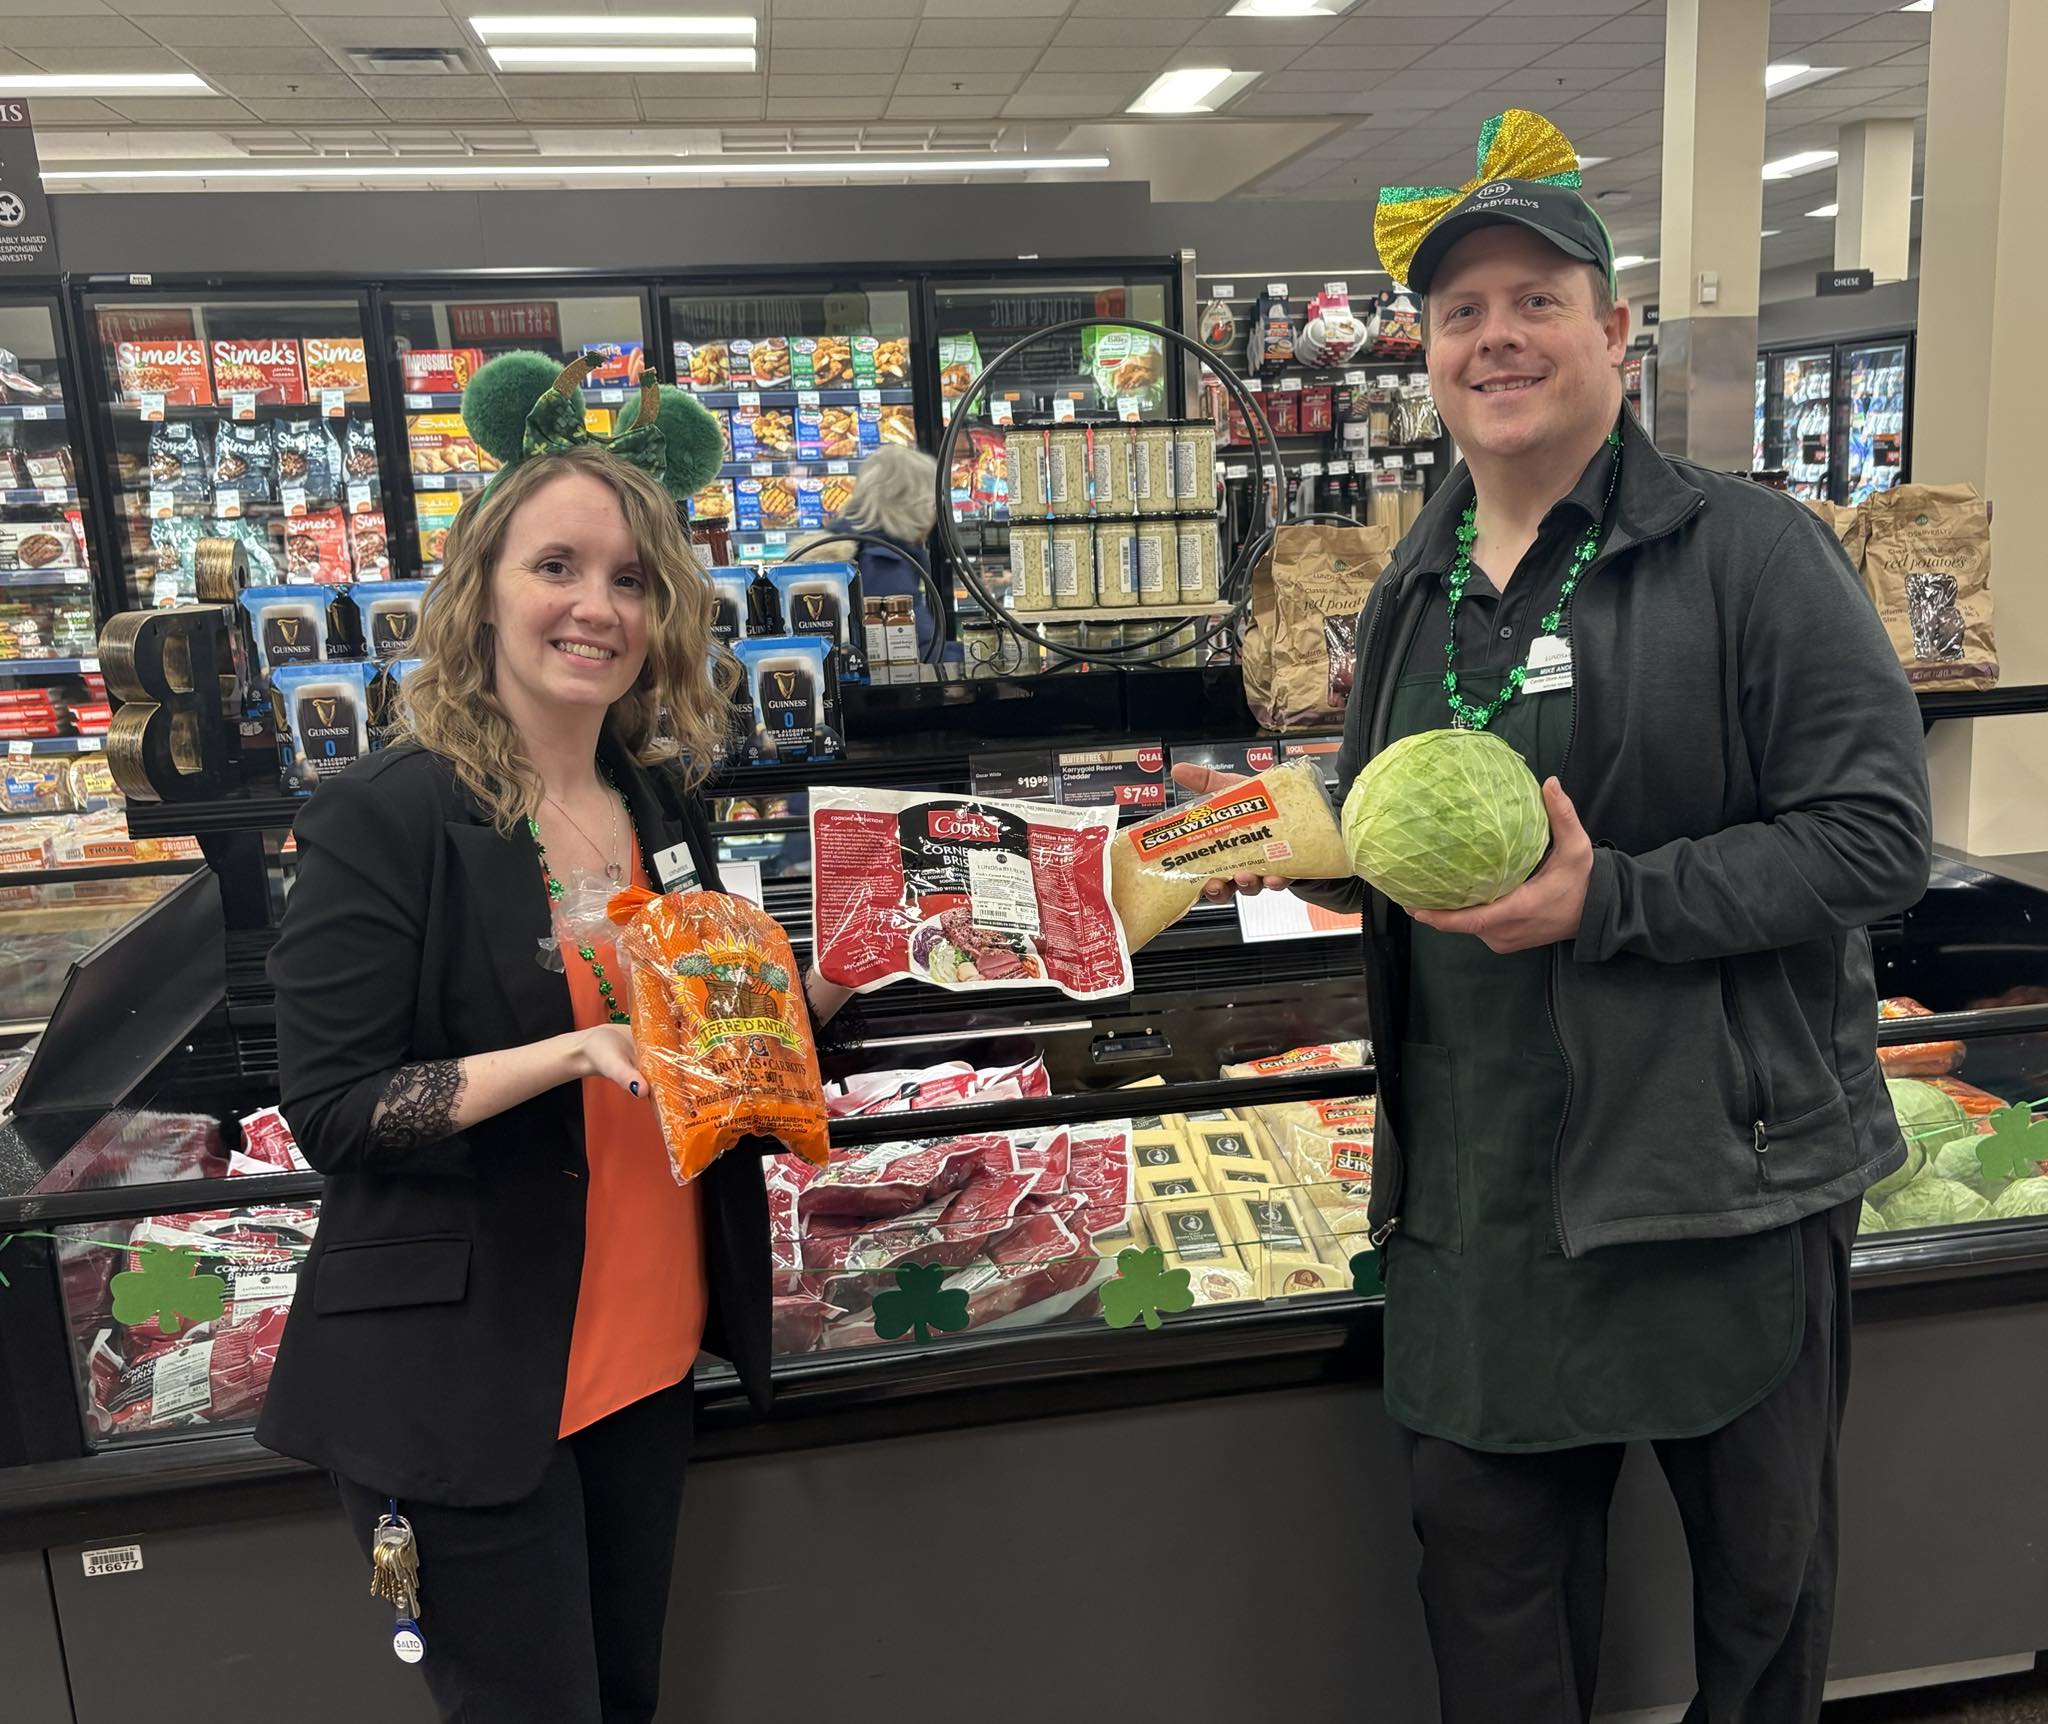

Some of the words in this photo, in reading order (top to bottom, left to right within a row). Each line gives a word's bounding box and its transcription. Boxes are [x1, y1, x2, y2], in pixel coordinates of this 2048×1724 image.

[1465, 198, 1540, 213] DS&BYERLYS
[20, 236, 47, 244] RAISED
[1833, 277, 1859, 287] CHEESE
[118, 342, 202, 367] Simek's
[214, 342, 297, 366] Simek's
[307, 340, 366, 364] Sime
[406, 353, 454, 371] IMPOSSIBLE
[288, 518, 337, 532] Simek's
[1884, 554, 1909, 569] red
[1910, 556, 1967, 571] potatoes
[710, 625, 732, 633] NNESS
[799, 621, 834, 629] GUINNESS
[272, 645, 311, 654] GUINNESS
[1540, 666, 1556, 675] MIKE
[768, 700, 808, 709] GUINNESS
[308, 727, 350, 737] GUINNESS
[1286, 746, 1304, 754] LOCAL
[1061, 754, 1085, 763] GLUTEN
[1140, 754, 1163, 762] DEAL
[1250, 752, 1273, 761] DEAL
[1062, 765, 1095, 774] Kerrygold
[1063, 773, 1092, 781] Cheddar
[935, 816, 992, 838] Cook's
[1145, 798, 1267, 848] SCHWEIGERT
[1032, 832, 1056, 841] Nutrition
[162, 838, 200, 851] ORIGINAL
[1161, 825, 1273, 872] Sauerkraut
[0, 850, 32, 863] RIGINAL
[923, 845, 969, 857] CORNE
[943, 855, 969, 867] BRIS
[700, 1020, 742, 1047] TERRE
[769, 1058, 806, 1075] CARROTS
[1337, 1126, 1374, 1136] Sauer
[120, 1360, 156, 1383] CORNE
[131, 1367, 156, 1384] BRIS
[88, 1560, 139, 1574] 316677
[396, 1640, 420, 1649] SALTO
